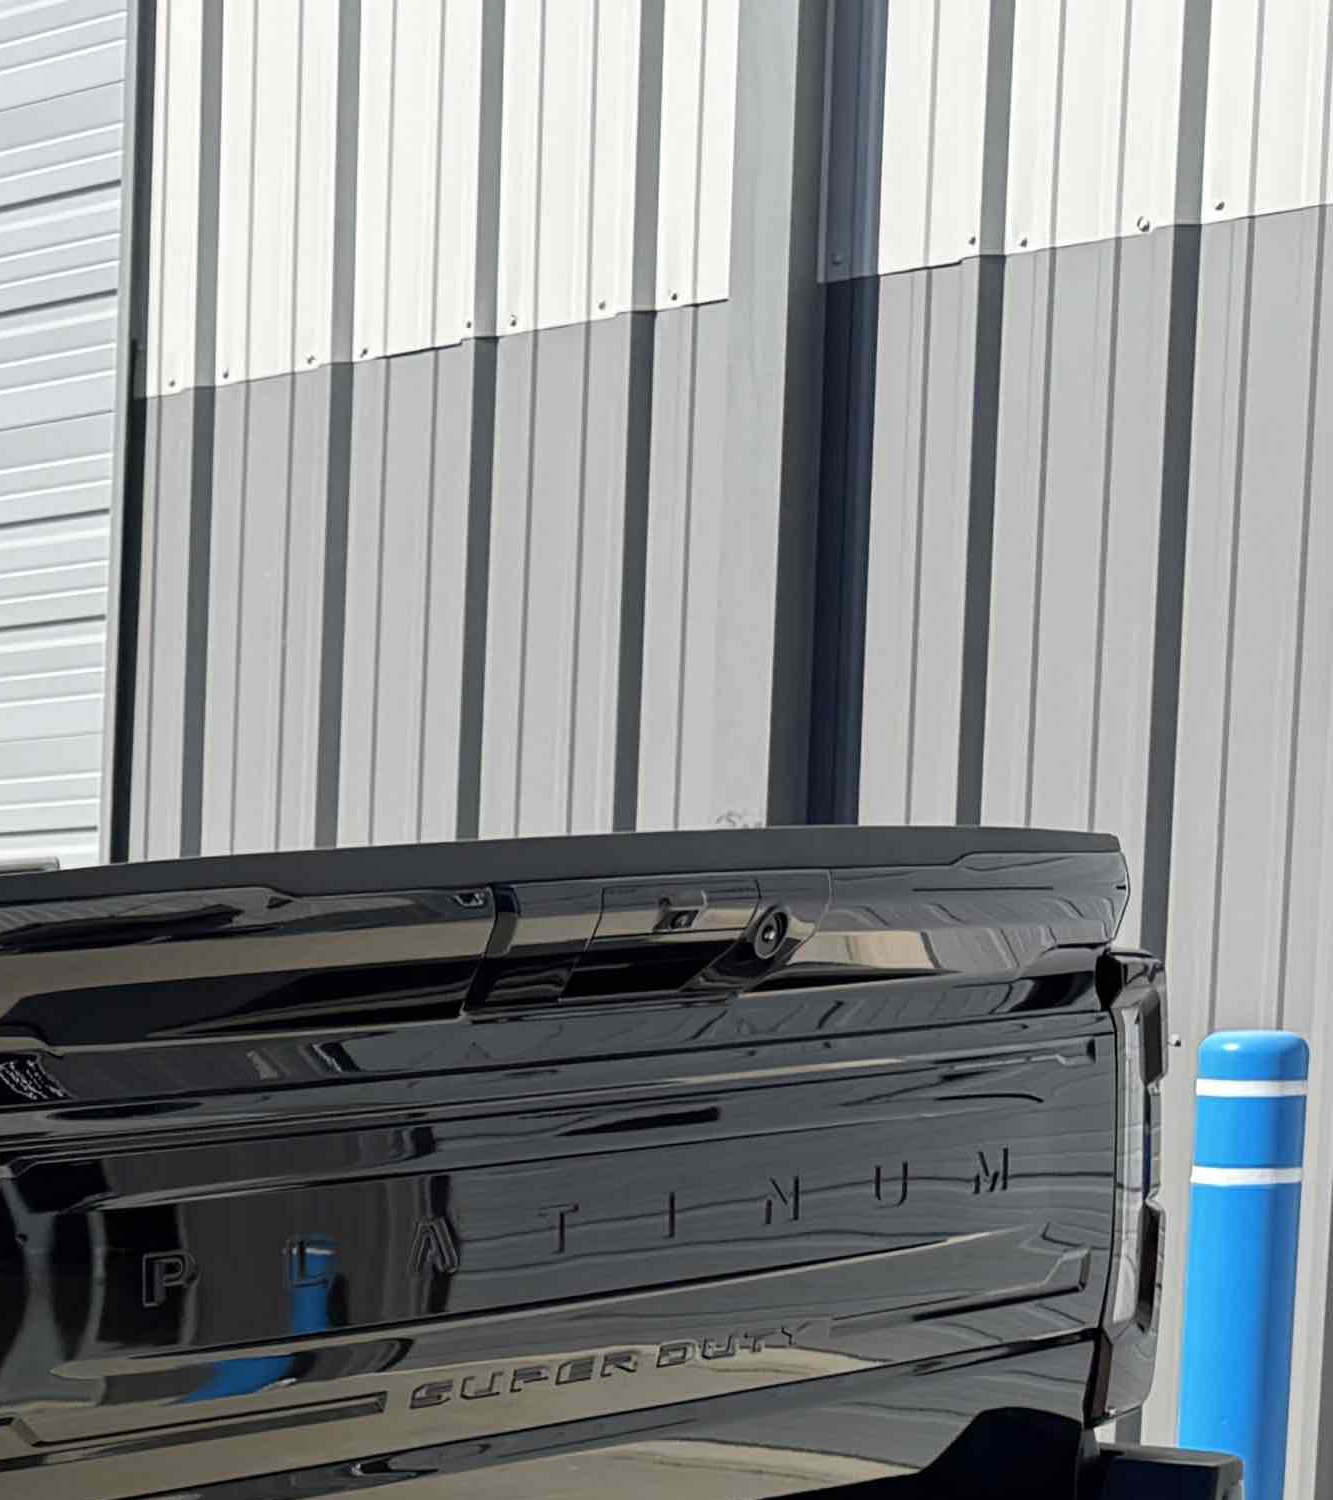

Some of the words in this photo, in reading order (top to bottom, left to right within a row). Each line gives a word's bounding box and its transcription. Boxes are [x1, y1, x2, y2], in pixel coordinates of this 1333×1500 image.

[140, 1145, 1011, 1308] PLATINUM
[409, 1351, 638, 1410] SUPER
[655, 1319, 812, 1369] DUTY
